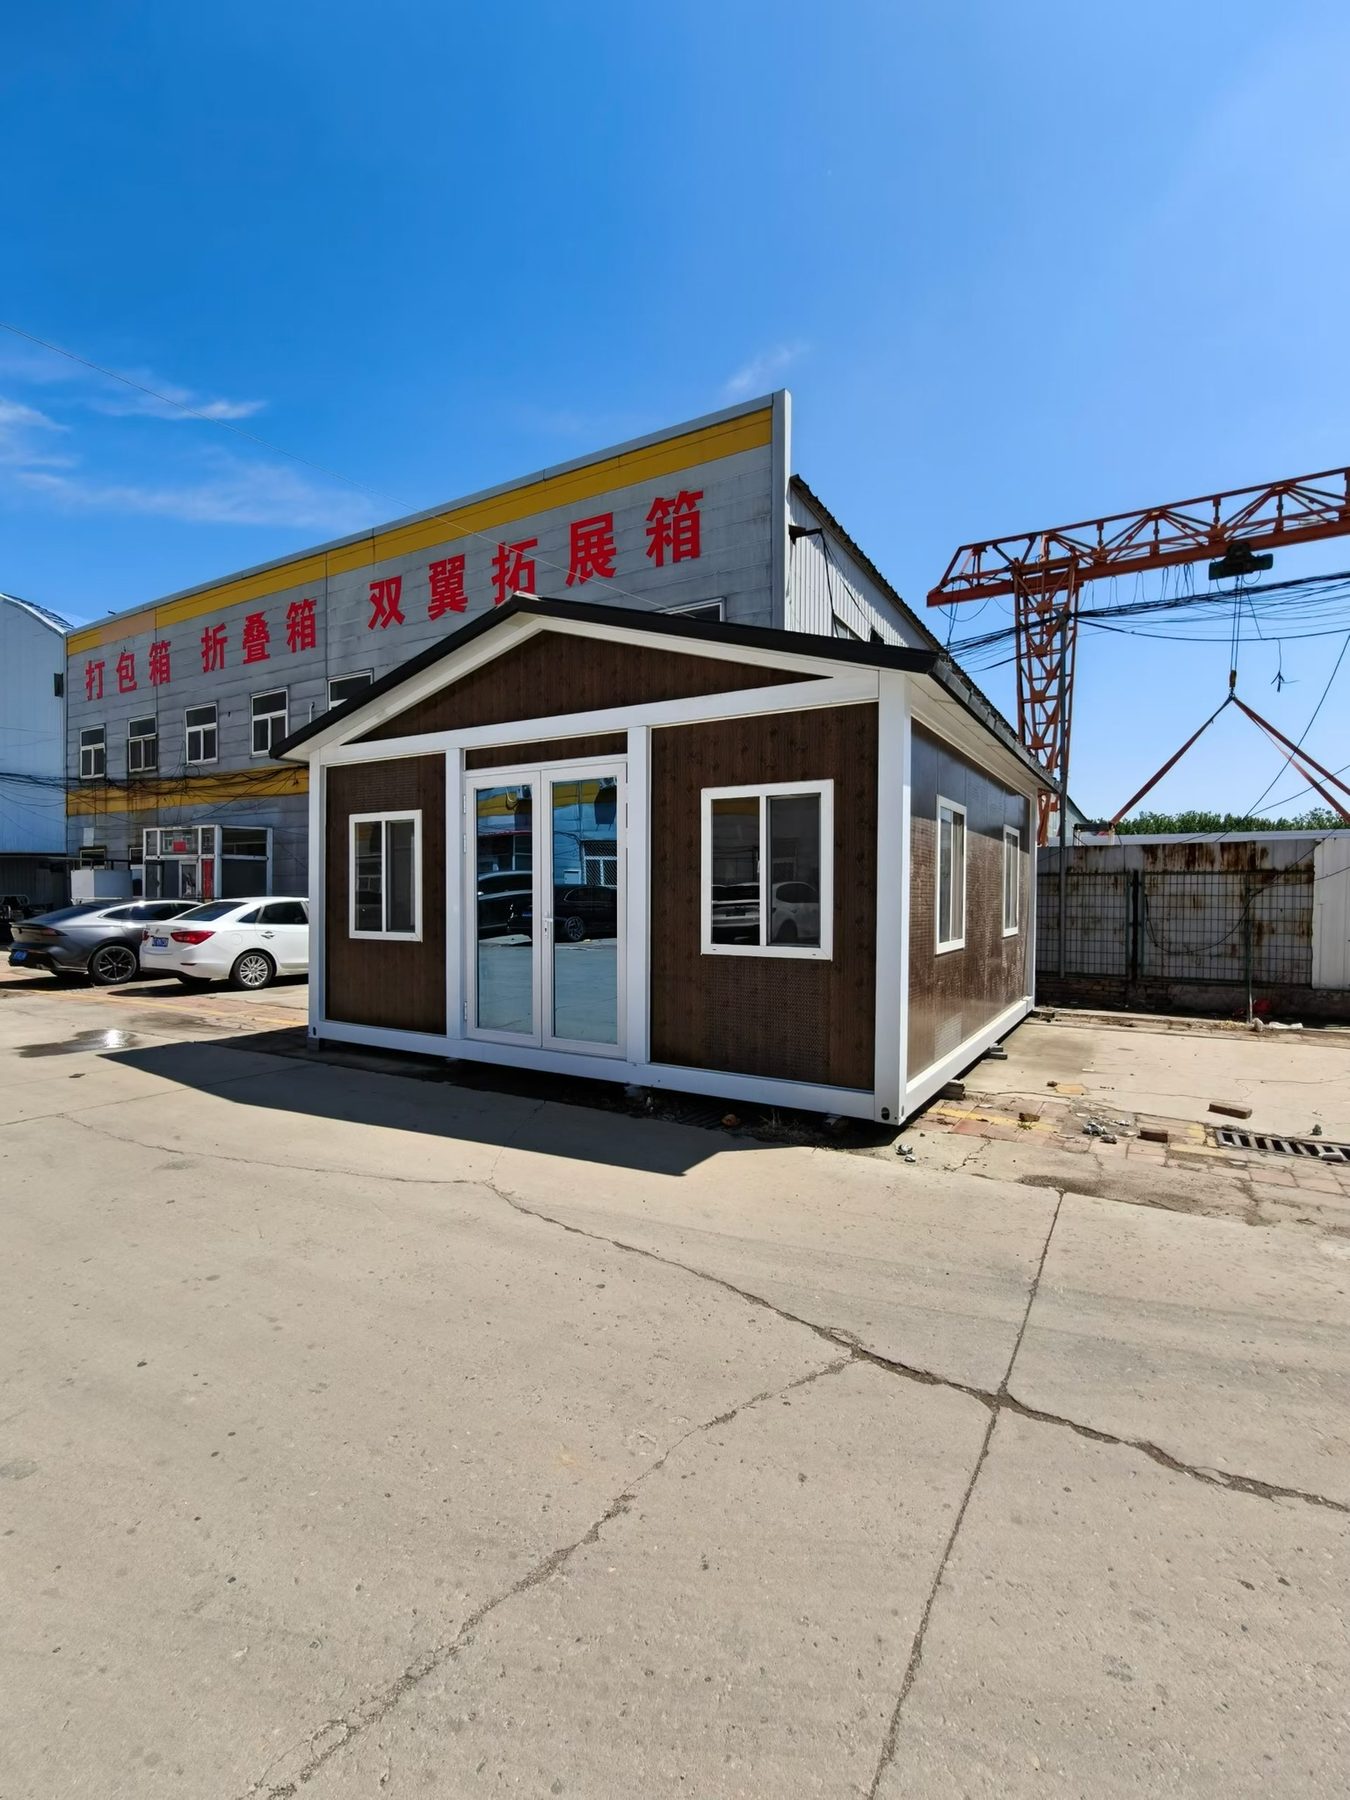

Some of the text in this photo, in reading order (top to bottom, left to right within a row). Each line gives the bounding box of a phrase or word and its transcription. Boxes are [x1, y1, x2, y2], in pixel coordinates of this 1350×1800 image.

[85, 490, 704, 701] 打包箱 折叠箱 双翼拓展箱
